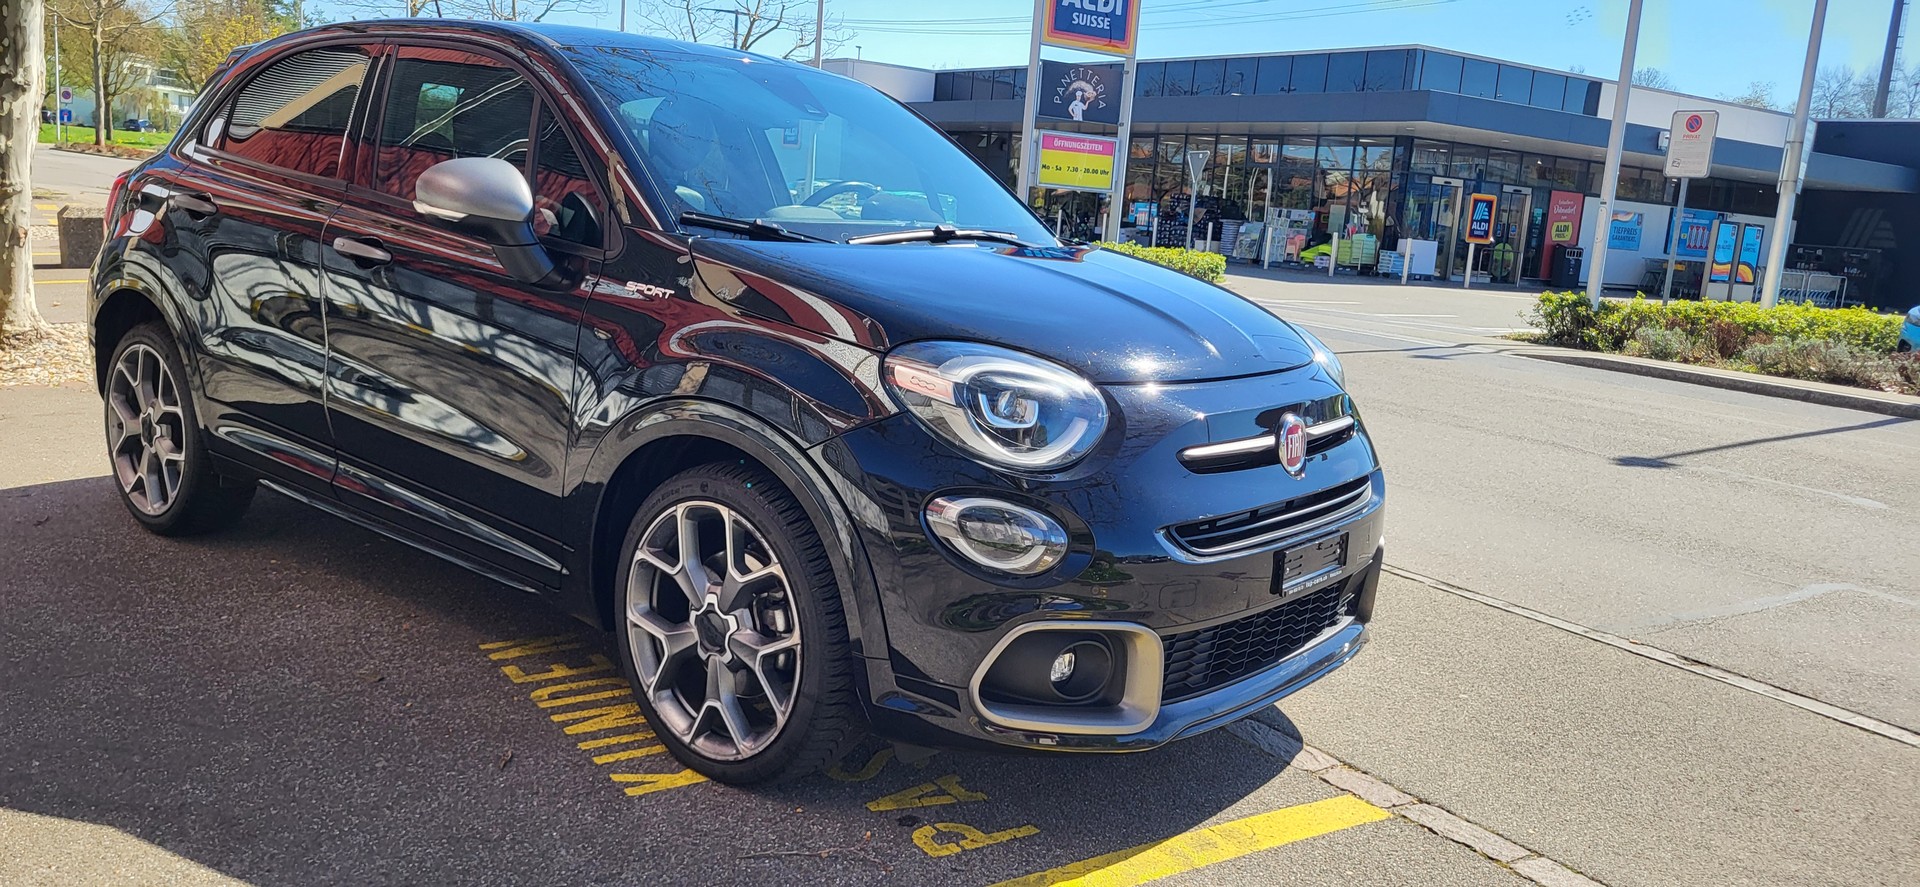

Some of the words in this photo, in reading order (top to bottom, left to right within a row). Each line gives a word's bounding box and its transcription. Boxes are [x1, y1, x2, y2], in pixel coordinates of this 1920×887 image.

[1072, 12, 1111, 30] SUISSE
[1053, 67, 1107, 110] PANETTERIA
[1053, 138, 1103, 151] ÖFFNUNGSZEITEN
[1083, 167, 1099, 175] 20.00
[1472, 221, 1489, 230] ALDI
[1555, 224, 1570, 233] ALDI
[624, 280, 675, 299] SPORT
[1287, 431, 1304, 459] FIAT
